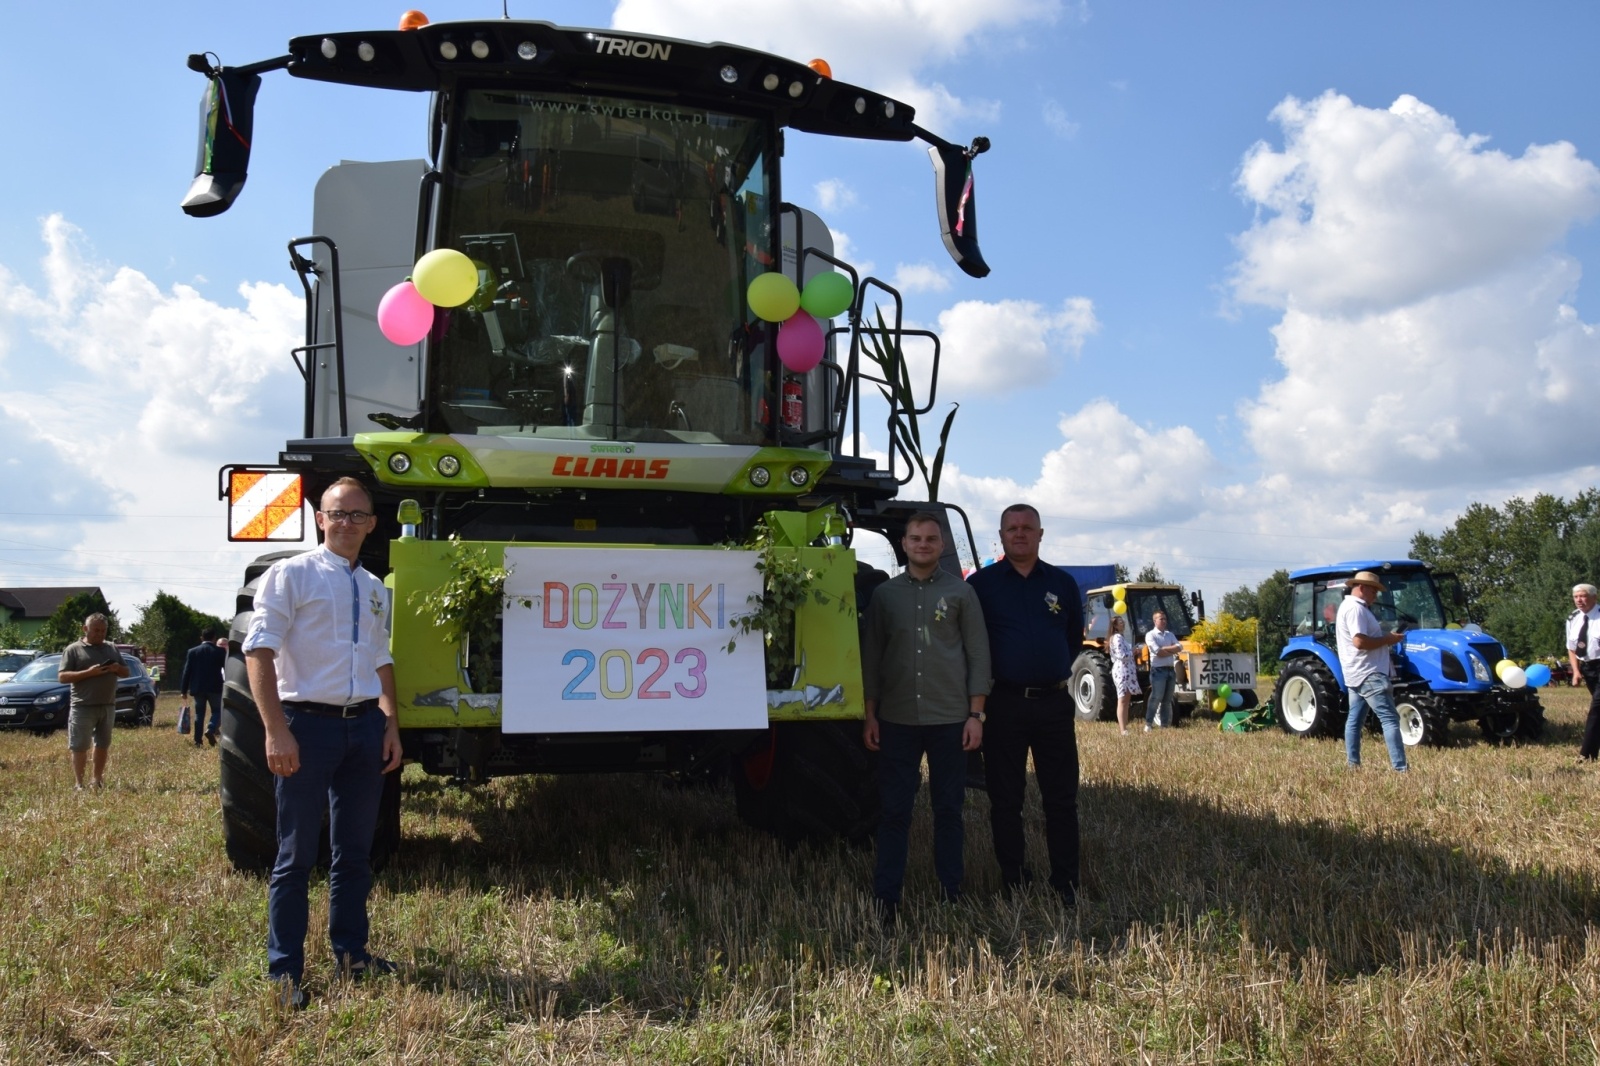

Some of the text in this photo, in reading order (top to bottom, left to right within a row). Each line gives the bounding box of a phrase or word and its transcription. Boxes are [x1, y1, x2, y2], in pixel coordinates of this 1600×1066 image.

[595, 36, 672, 61] TRION
[530, 100, 710, 127] www.swierkot.pl
[551, 455, 671, 480] CLAAS
[543, 573, 724, 630] DOŻYNKI
[561, 647, 707, 700] 2023
[1200, 672, 1251, 685] MSZANA
